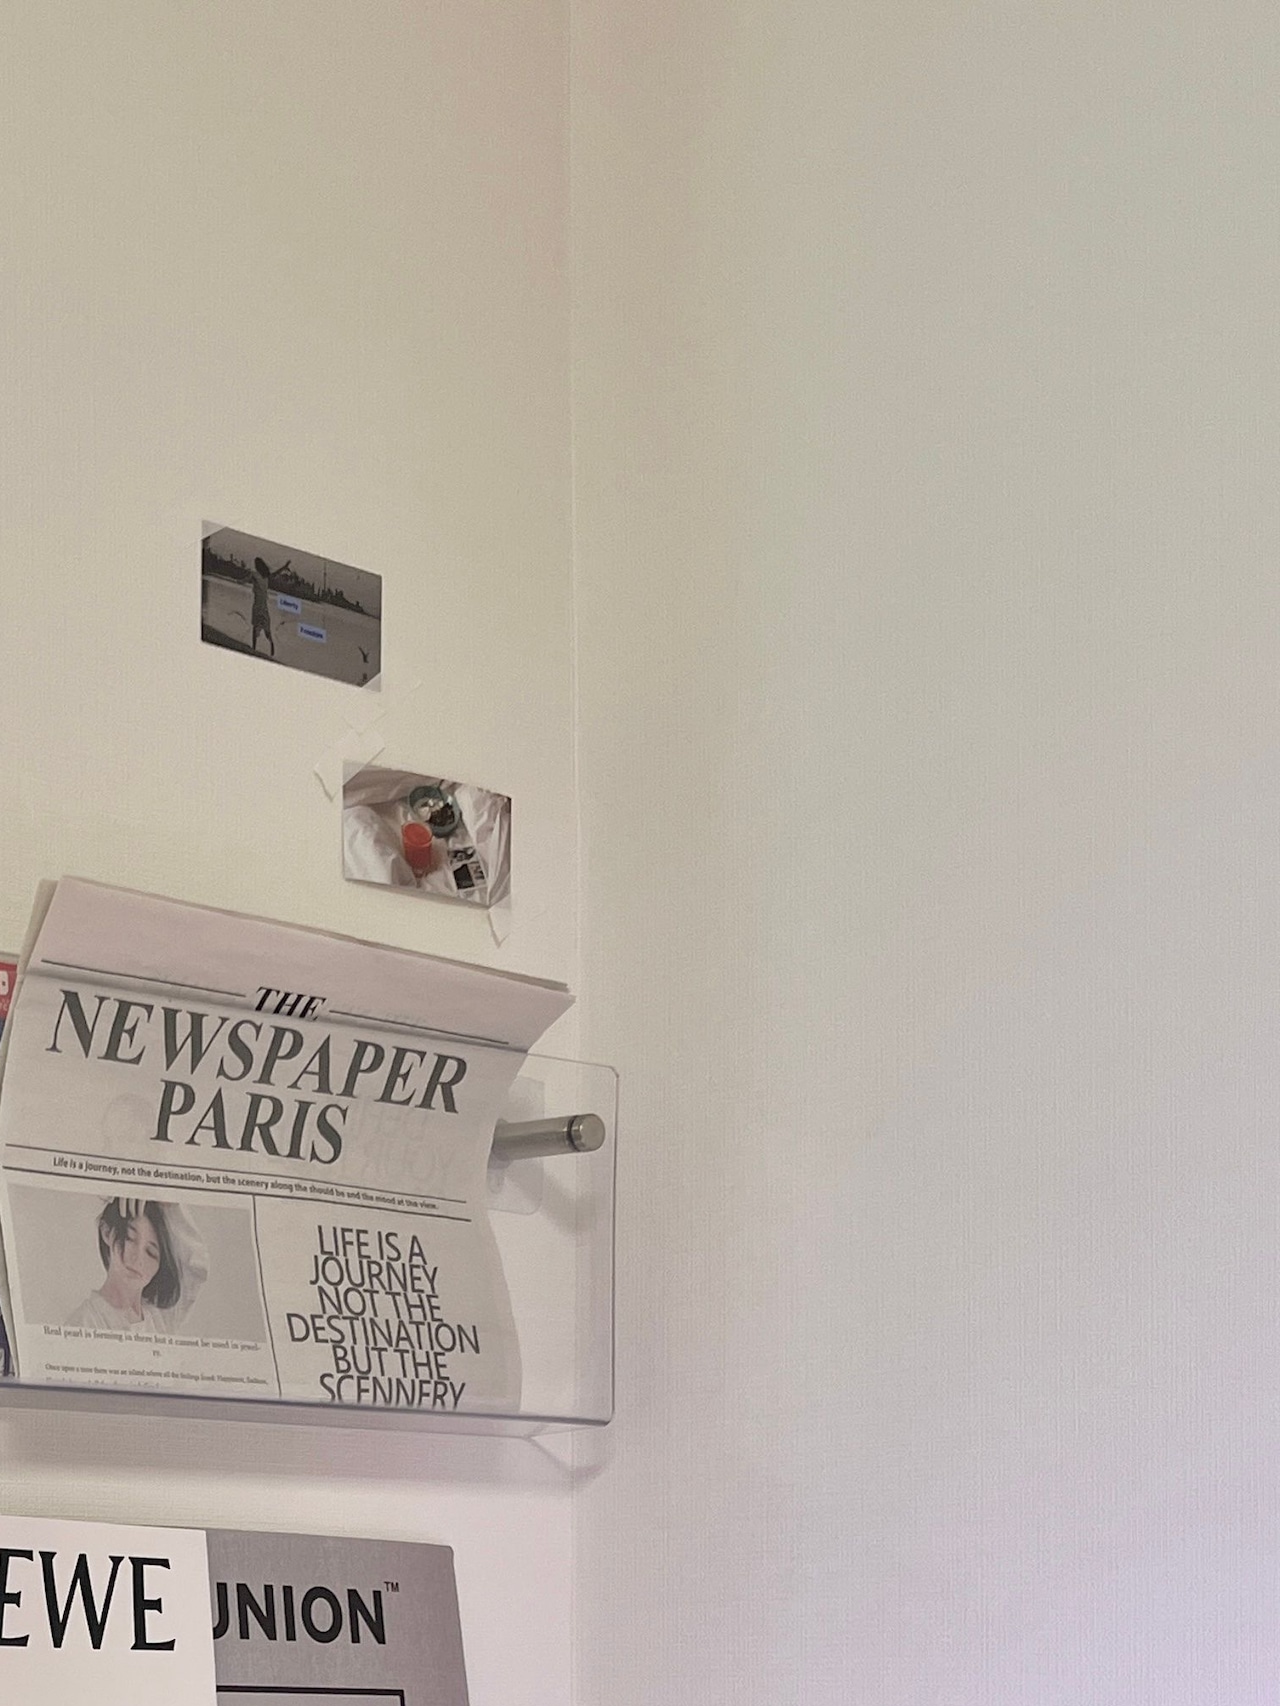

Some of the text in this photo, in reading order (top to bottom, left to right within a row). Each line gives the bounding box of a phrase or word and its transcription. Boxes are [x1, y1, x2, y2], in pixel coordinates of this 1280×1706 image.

[254, 986, 329, 1022] THE
[46, 989, 468, 1114] NEWSPAPER
[150, 1079, 350, 1165] PARIS
[53, 1156, 68, 1169] Life
[70, 1158, 77, 1170] is
[78, 1161, 83, 1170] a
[84, 1161, 120, 1176] journey,
[121, 1166, 135, 1177] not
[137, 1167, 152, 1178] the
[154, 1168, 205, 1183] destination,
[206, 1173, 220, 1184] but
[222, 1174, 237, 1186] the
[238, 1176, 269, 1190] scenery
[318, 1225, 427, 1266] LIFE IS A
[310, 1255, 438, 1295] JOURNEY
[318, 1285, 443, 1323] NOT THE
[286, 1312, 480, 1355] DESTINATION
[332, 1345, 450, 1381] BUT THE
[320, 1373, 466, 1410] SCENNERY
